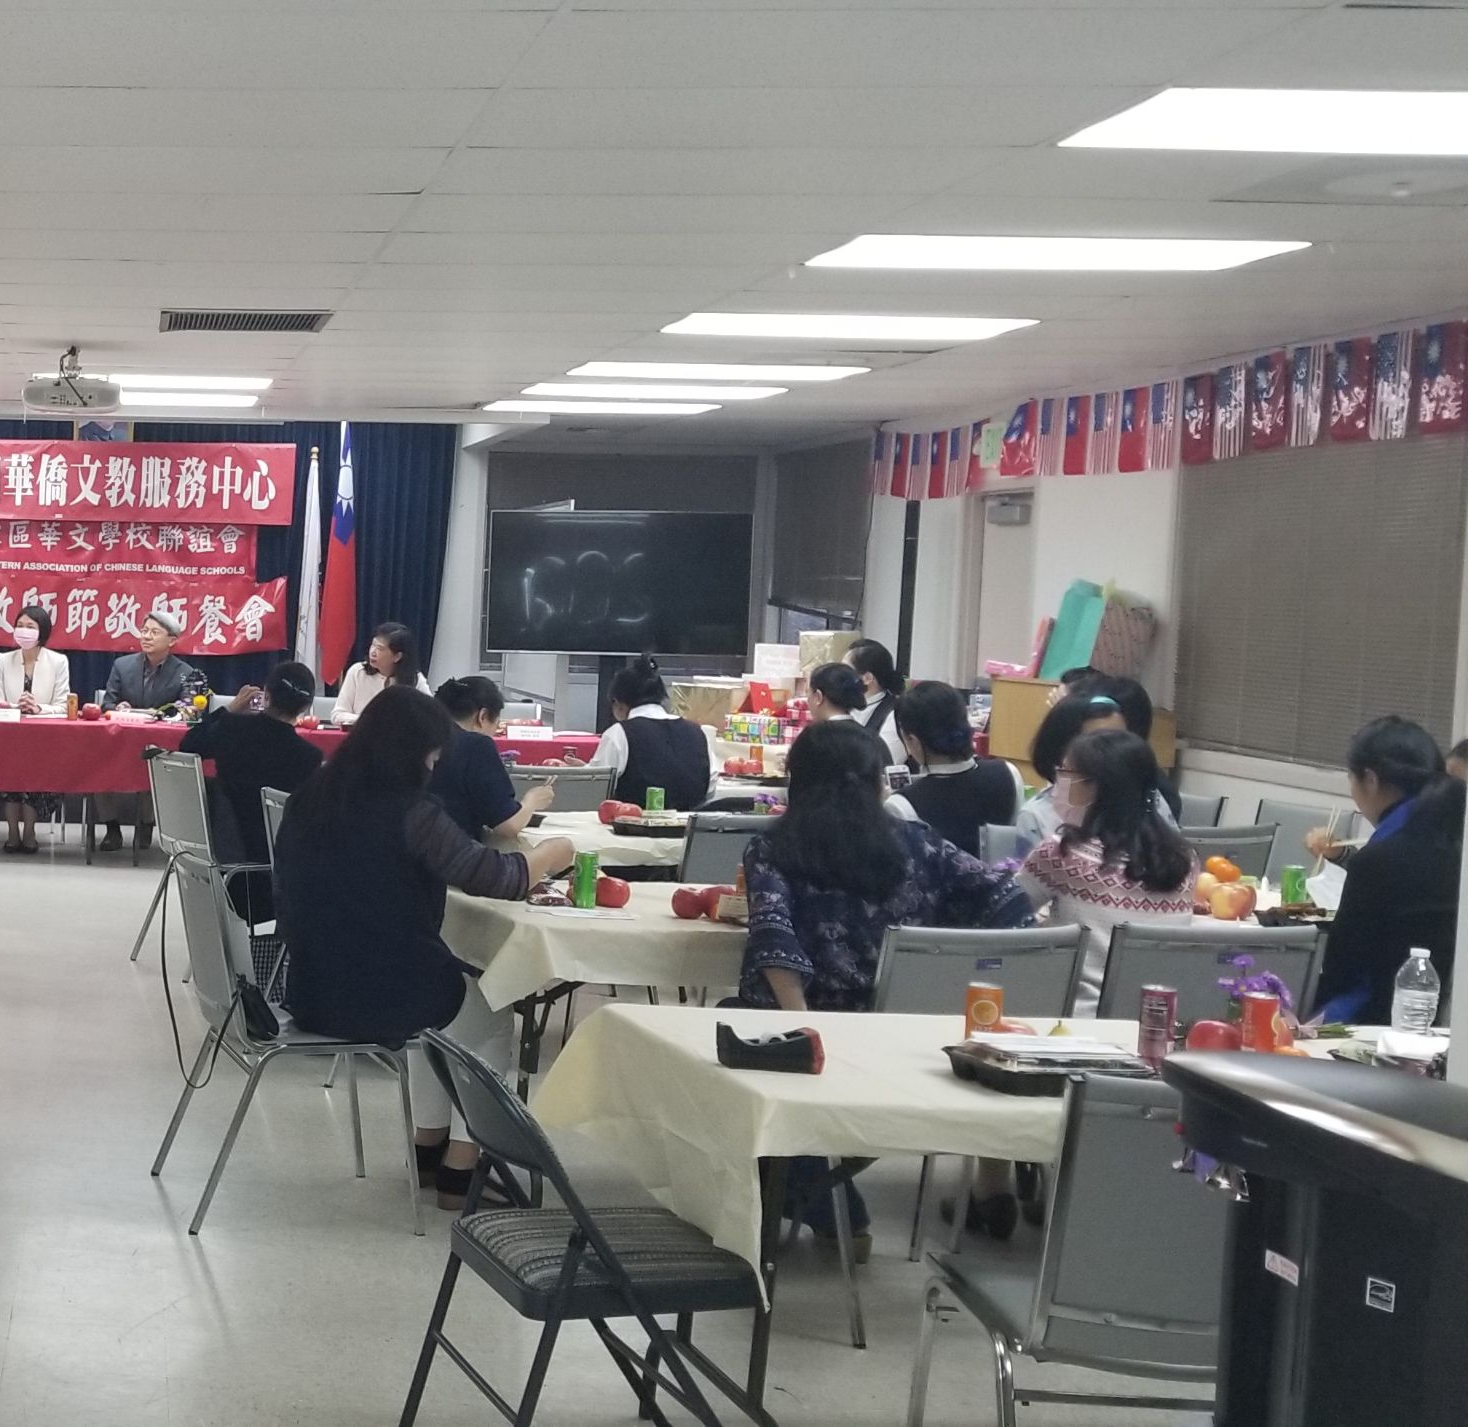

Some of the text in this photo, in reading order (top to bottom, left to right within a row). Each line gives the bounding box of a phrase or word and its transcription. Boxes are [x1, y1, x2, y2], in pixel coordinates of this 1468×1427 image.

[23, 562, 87, 572] ASSOCIATION
[90, 563, 102, 572] OF
[104, 563, 144, 573] CHINESE
[145, 564, 198, 575] LANGUAGE
[199, 566, 246, 575] SCHOOLS
